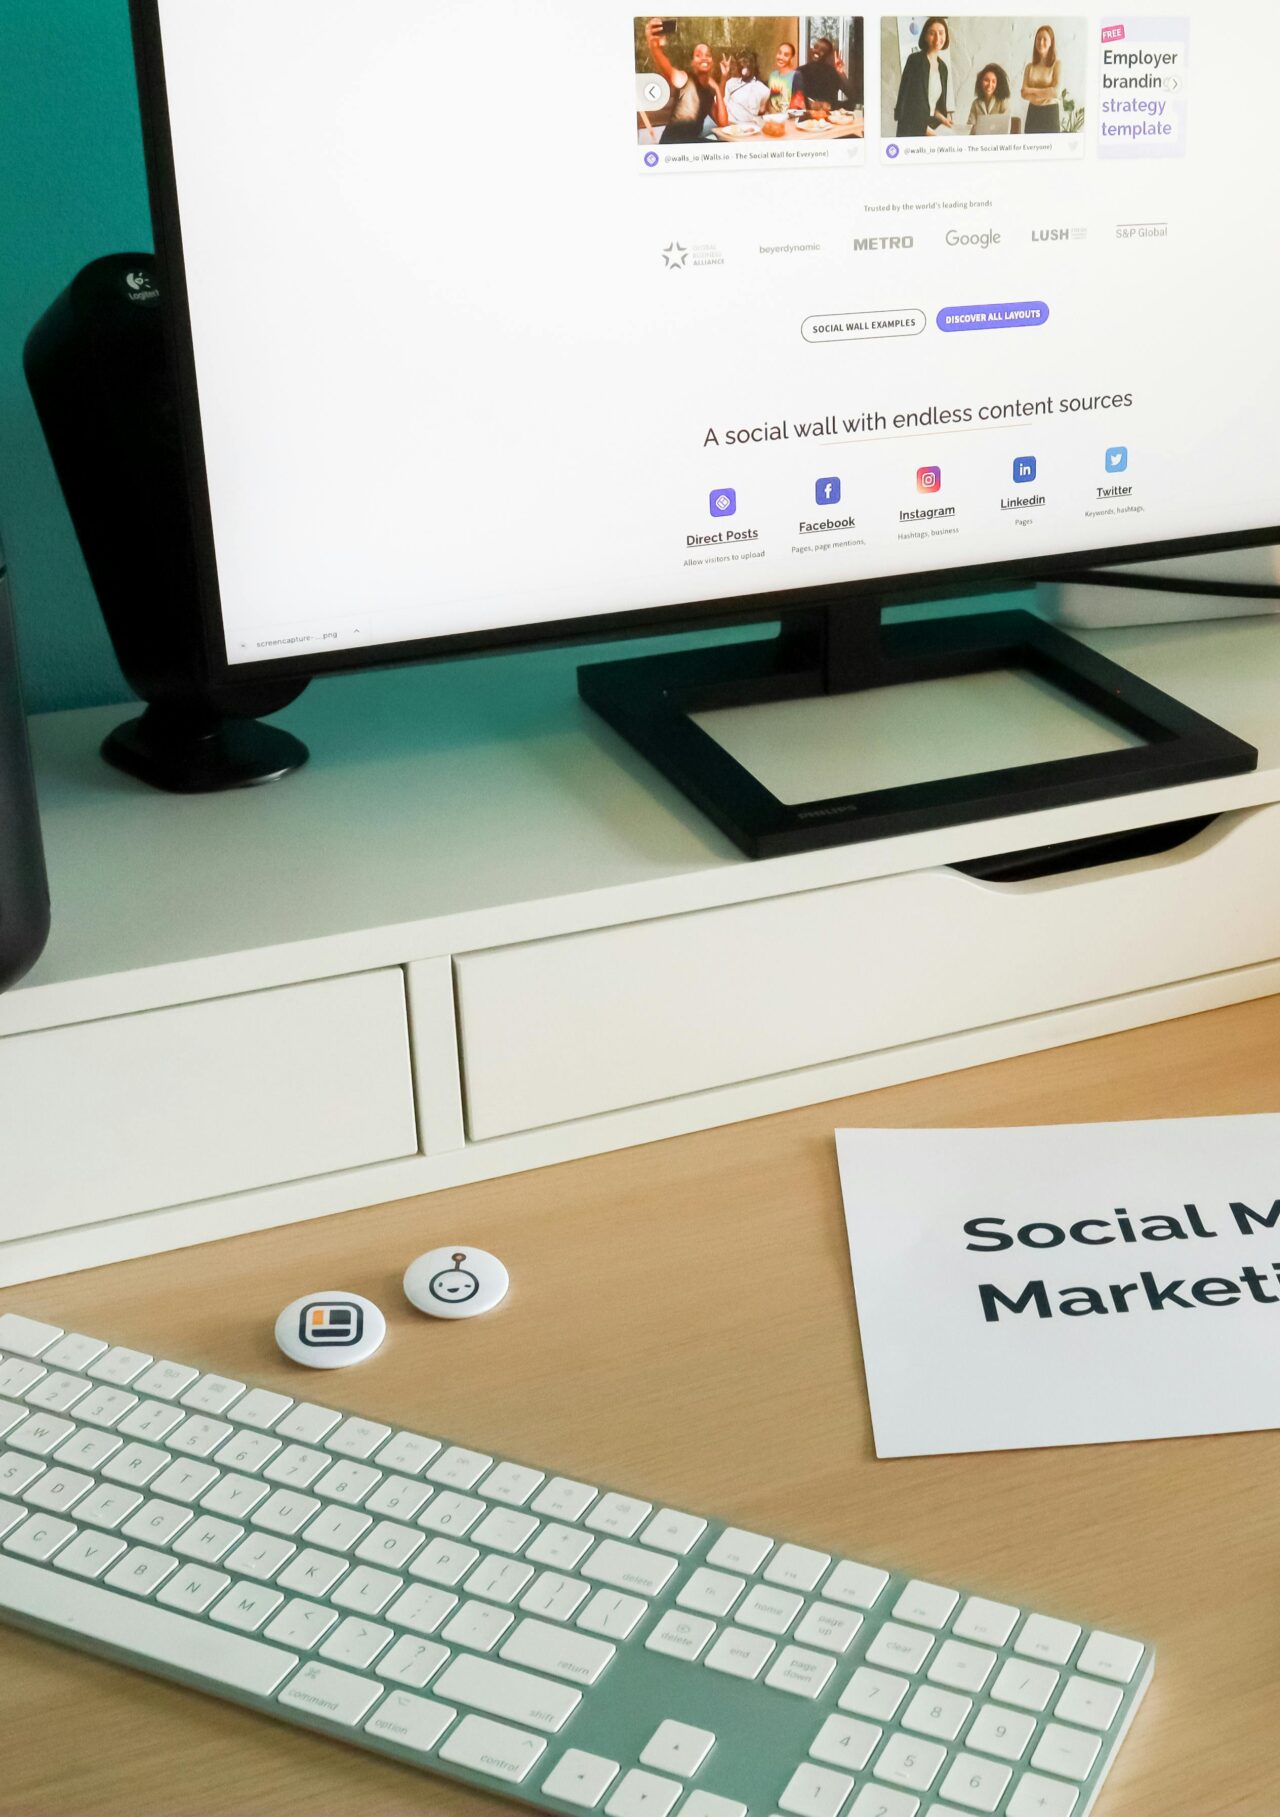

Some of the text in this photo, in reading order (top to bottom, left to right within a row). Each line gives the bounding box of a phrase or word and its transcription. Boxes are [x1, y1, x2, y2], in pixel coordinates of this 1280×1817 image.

[1102, 28, 1122, 39] FREE
[1104, 50, 1177, 69] Employer
[1102, 98, 1166, 116] strategy
[1101, 121, 1172, 139] template
[1023, 143, 1053, 152] Everyone)
[665, 155, 700, 164] @walls_io
[749, 152, 769, 160] Social
[770, 151, 786, 159] Wall
[796, 149, 829, 160] Everyone)
[864, 204, 890, 212] Trusted
[892, 203, 900, 213] by
[915, 202, 941, 210] world's
[942, 201, 968, 210] leading
[969, 200, 992, 208] brands
[945, 228, 1001, 249] Google
[1031, 228, 1069, 242] LUSH
[1115, 226, 1168, 239] S&P Global
[759, 242, 821, 255] beyerdynamic
[853, 235, 914, 251] METRO
[693, 258, 725, 266] ALLIANCE
[946, 309, 1041, 324] DISCOVER ALL LAYOUTS
[812, 318, 916, 334] SOCIAL WALL EXAMPLES
[703, 392, 1133, 447] A social wall with endless content sources
[1096, 485, 1133, 497] Twitter
[1000, 495, 1045, 509] Linkedin
[899, 506, 955, 522] Instagram
[1084, 508, 1115, 518] Keywords,
[799, 516, 856, 533] Facebook
[1014, 518, 1033, 527] Pages
[686, 528, 759, 546] Direct Posts
[897, 527, 960, 541] Hashtags, business
[791, 539, 866, 554] Pages, page mentions,
[683, 558, 703, 567] Allow
[704, 555, 730, 564] visitors
[740, 550, 765, 563] upload
[964, 1203, 1217, 1254] Social
[33, 1427, 49, 1438] W
[81, 1443, 96, 1454] E
[129, 1458, 143, 1469] R
[181, 1473, 192, 1484] T
[229, 1488, 241, 1499] Y
[280, 1505, 293, 1517] U
[622, 1573, 653, 1587] delete
[754, 1602, 784, 1616] home
[817, 1615, 845, 1629] page
[660, 1632, 694, 1647] delete
[818, 1627, 831, 1638] up
[730, 1646, 750, 1659] end
[557, 1659, 590, 1676] return
[790, 1658, 817, 1673] page
[783, 1669, 812, 1683] down
[288, 1689, 339, 1711] command
[529, 1707, 555, 1723] shift
[374, 1718, 409, 1736] option
[480, 1753, 521, 1773] control
